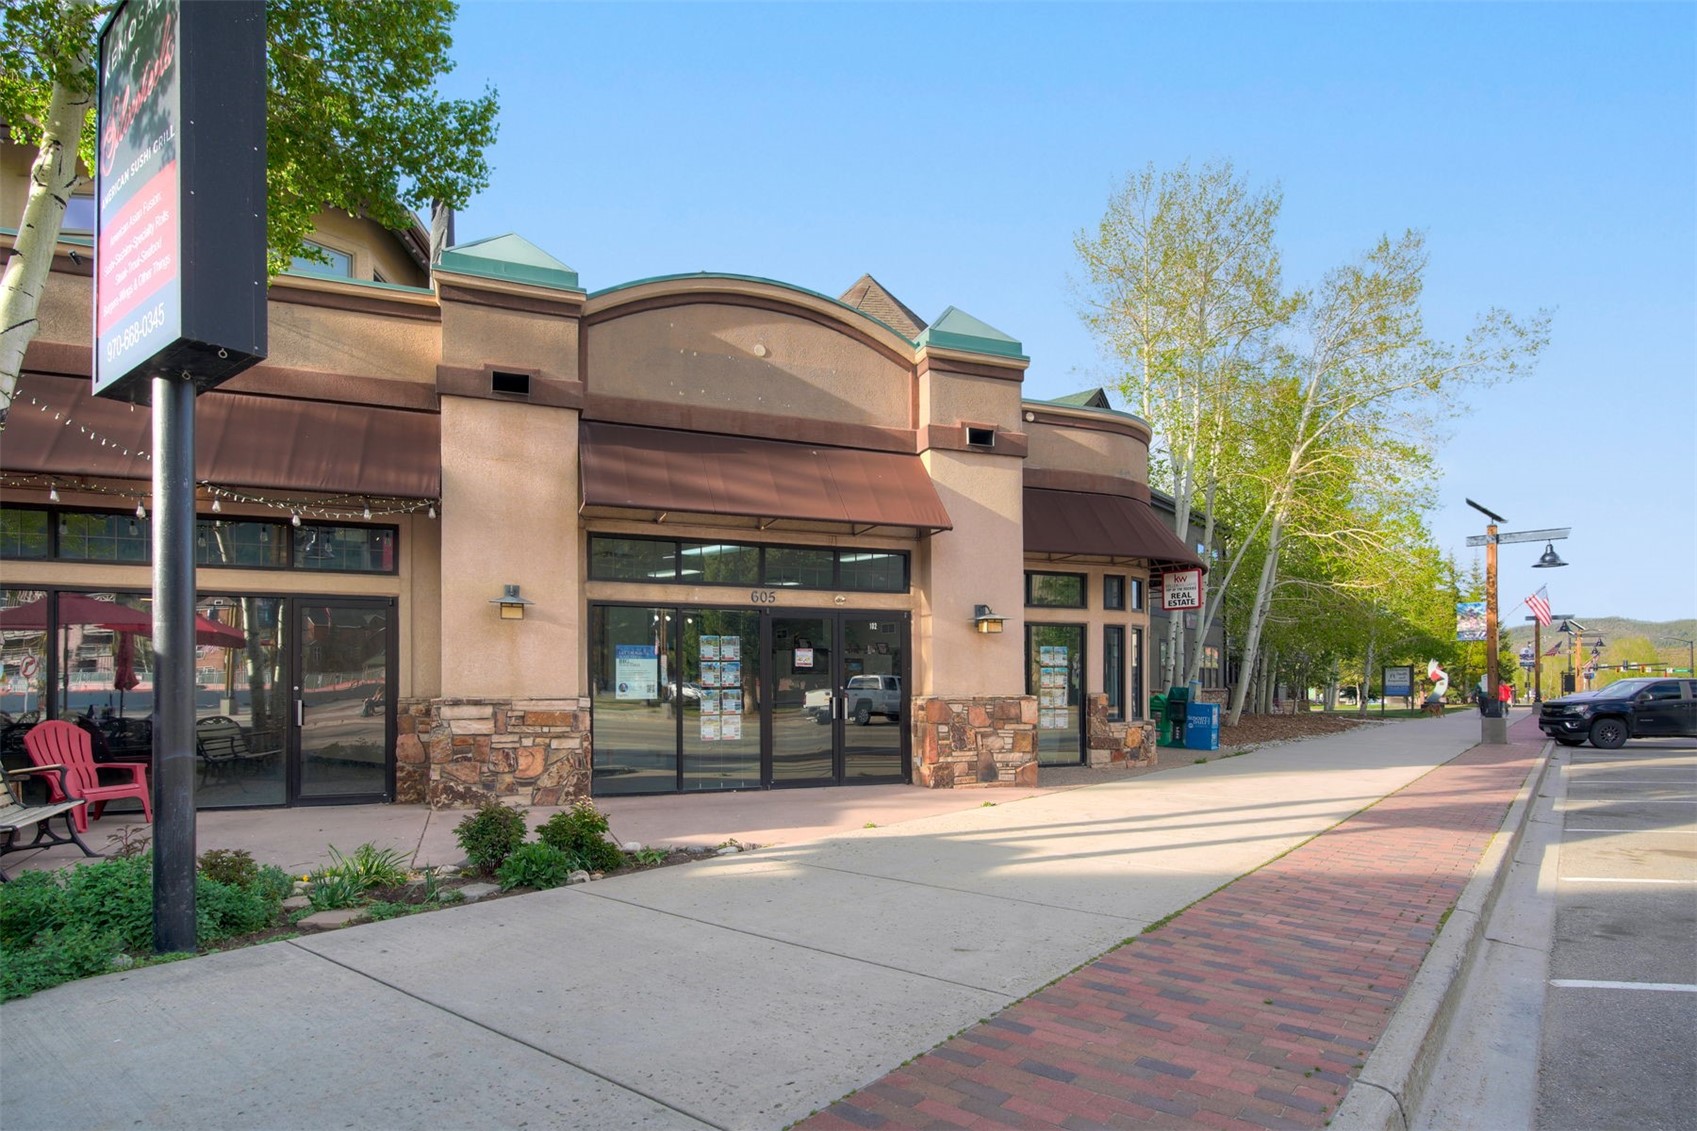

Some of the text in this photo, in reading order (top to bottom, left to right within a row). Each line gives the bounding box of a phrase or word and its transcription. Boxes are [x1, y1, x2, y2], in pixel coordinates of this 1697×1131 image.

[102, 124, 175, 210] AMERICAN SUSHI GRILL
[107, 303, 165, 362] 970-668-0345
[751, 591, 776, 603] 605
[1168, 598, 1195, 606] ESTATE
[869, 622, 877, 630] 102
